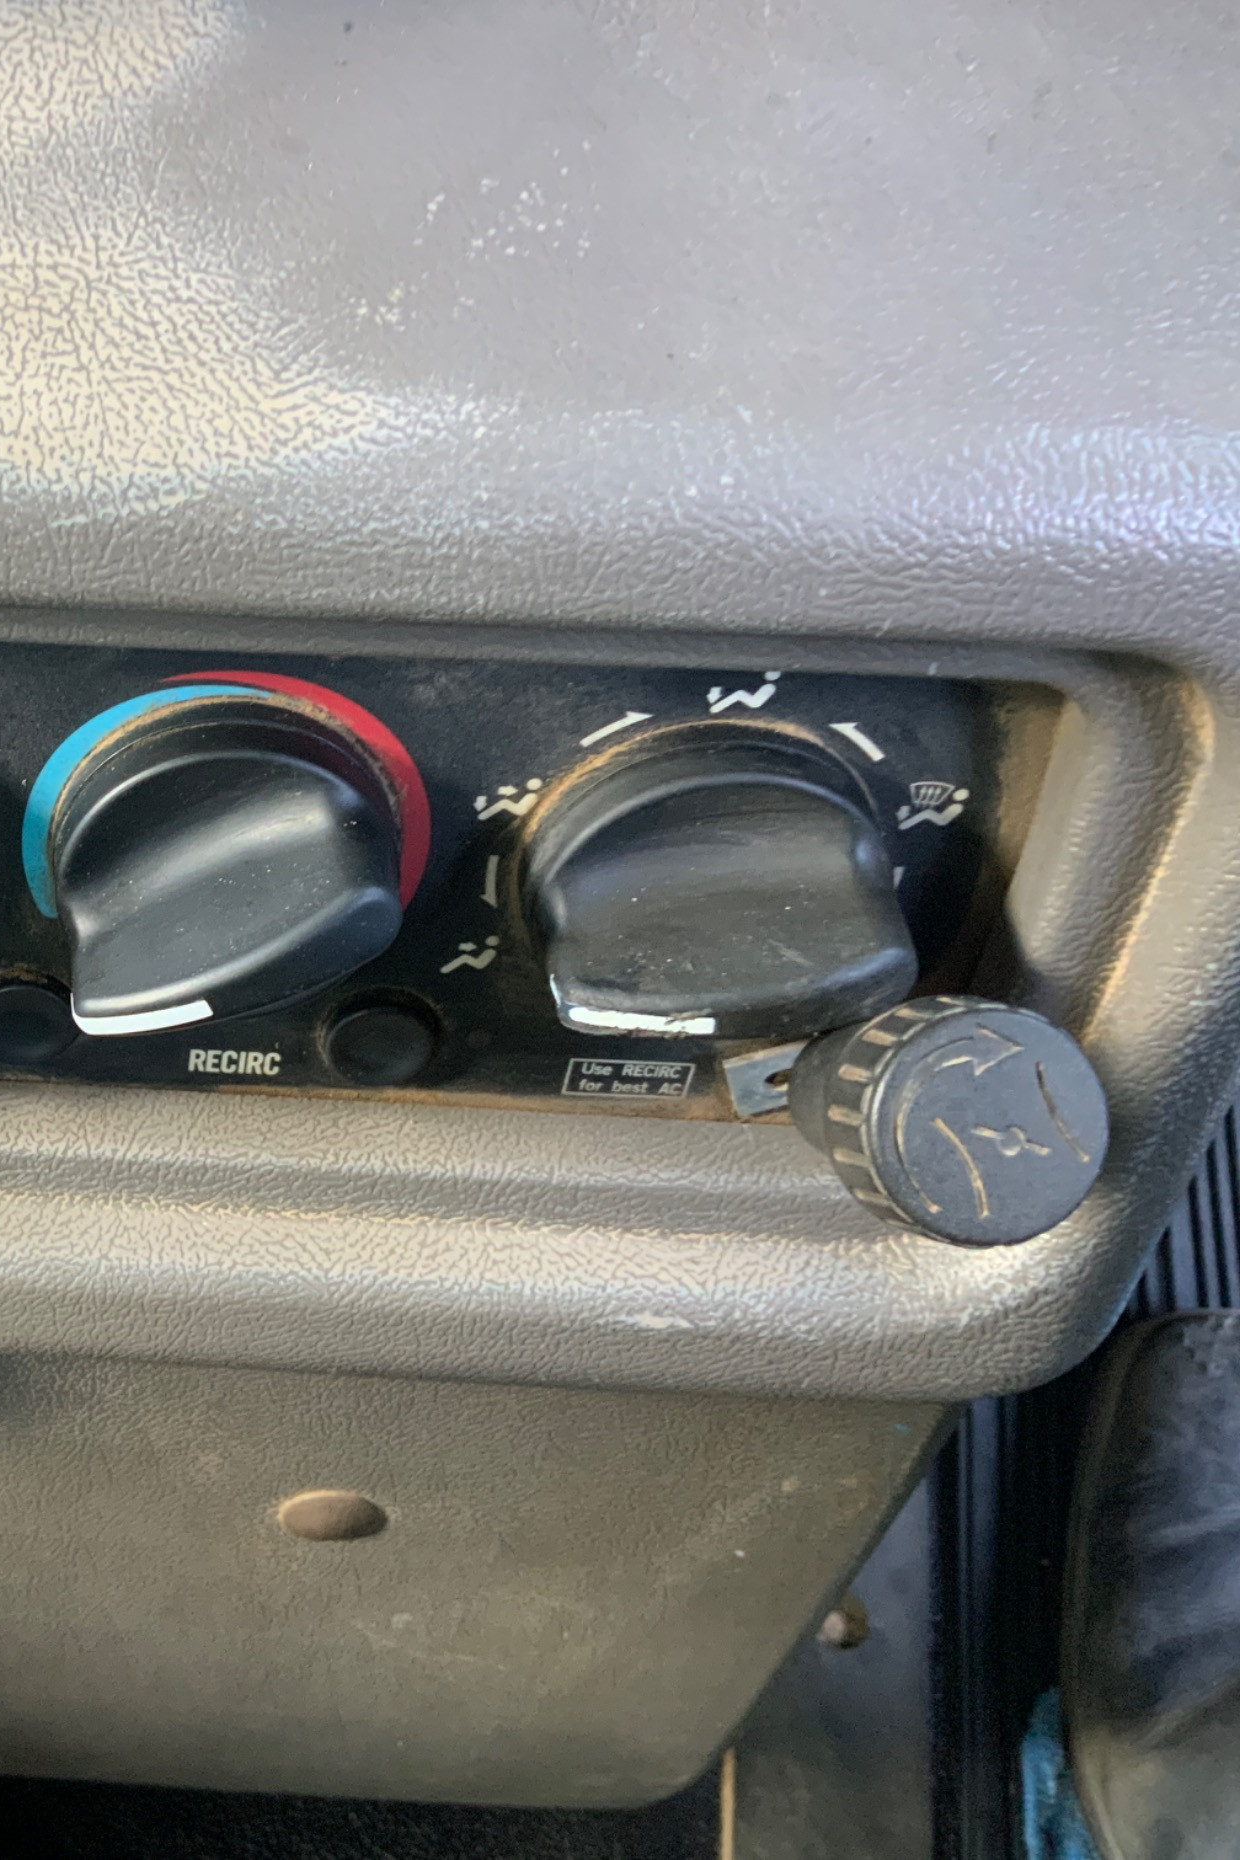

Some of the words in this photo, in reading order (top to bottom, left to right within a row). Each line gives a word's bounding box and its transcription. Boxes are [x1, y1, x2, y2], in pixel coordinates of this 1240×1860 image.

[187, 1048, 281, 1075] RECIRC
[581, 1062, 613, 1076] Use
[621, 1063, 682, 1078] RECIRC
[578, 1078, 604, 1091] for
[611, 1080, 649, 1093] best
[657, 1082, 682, 1095] AC
